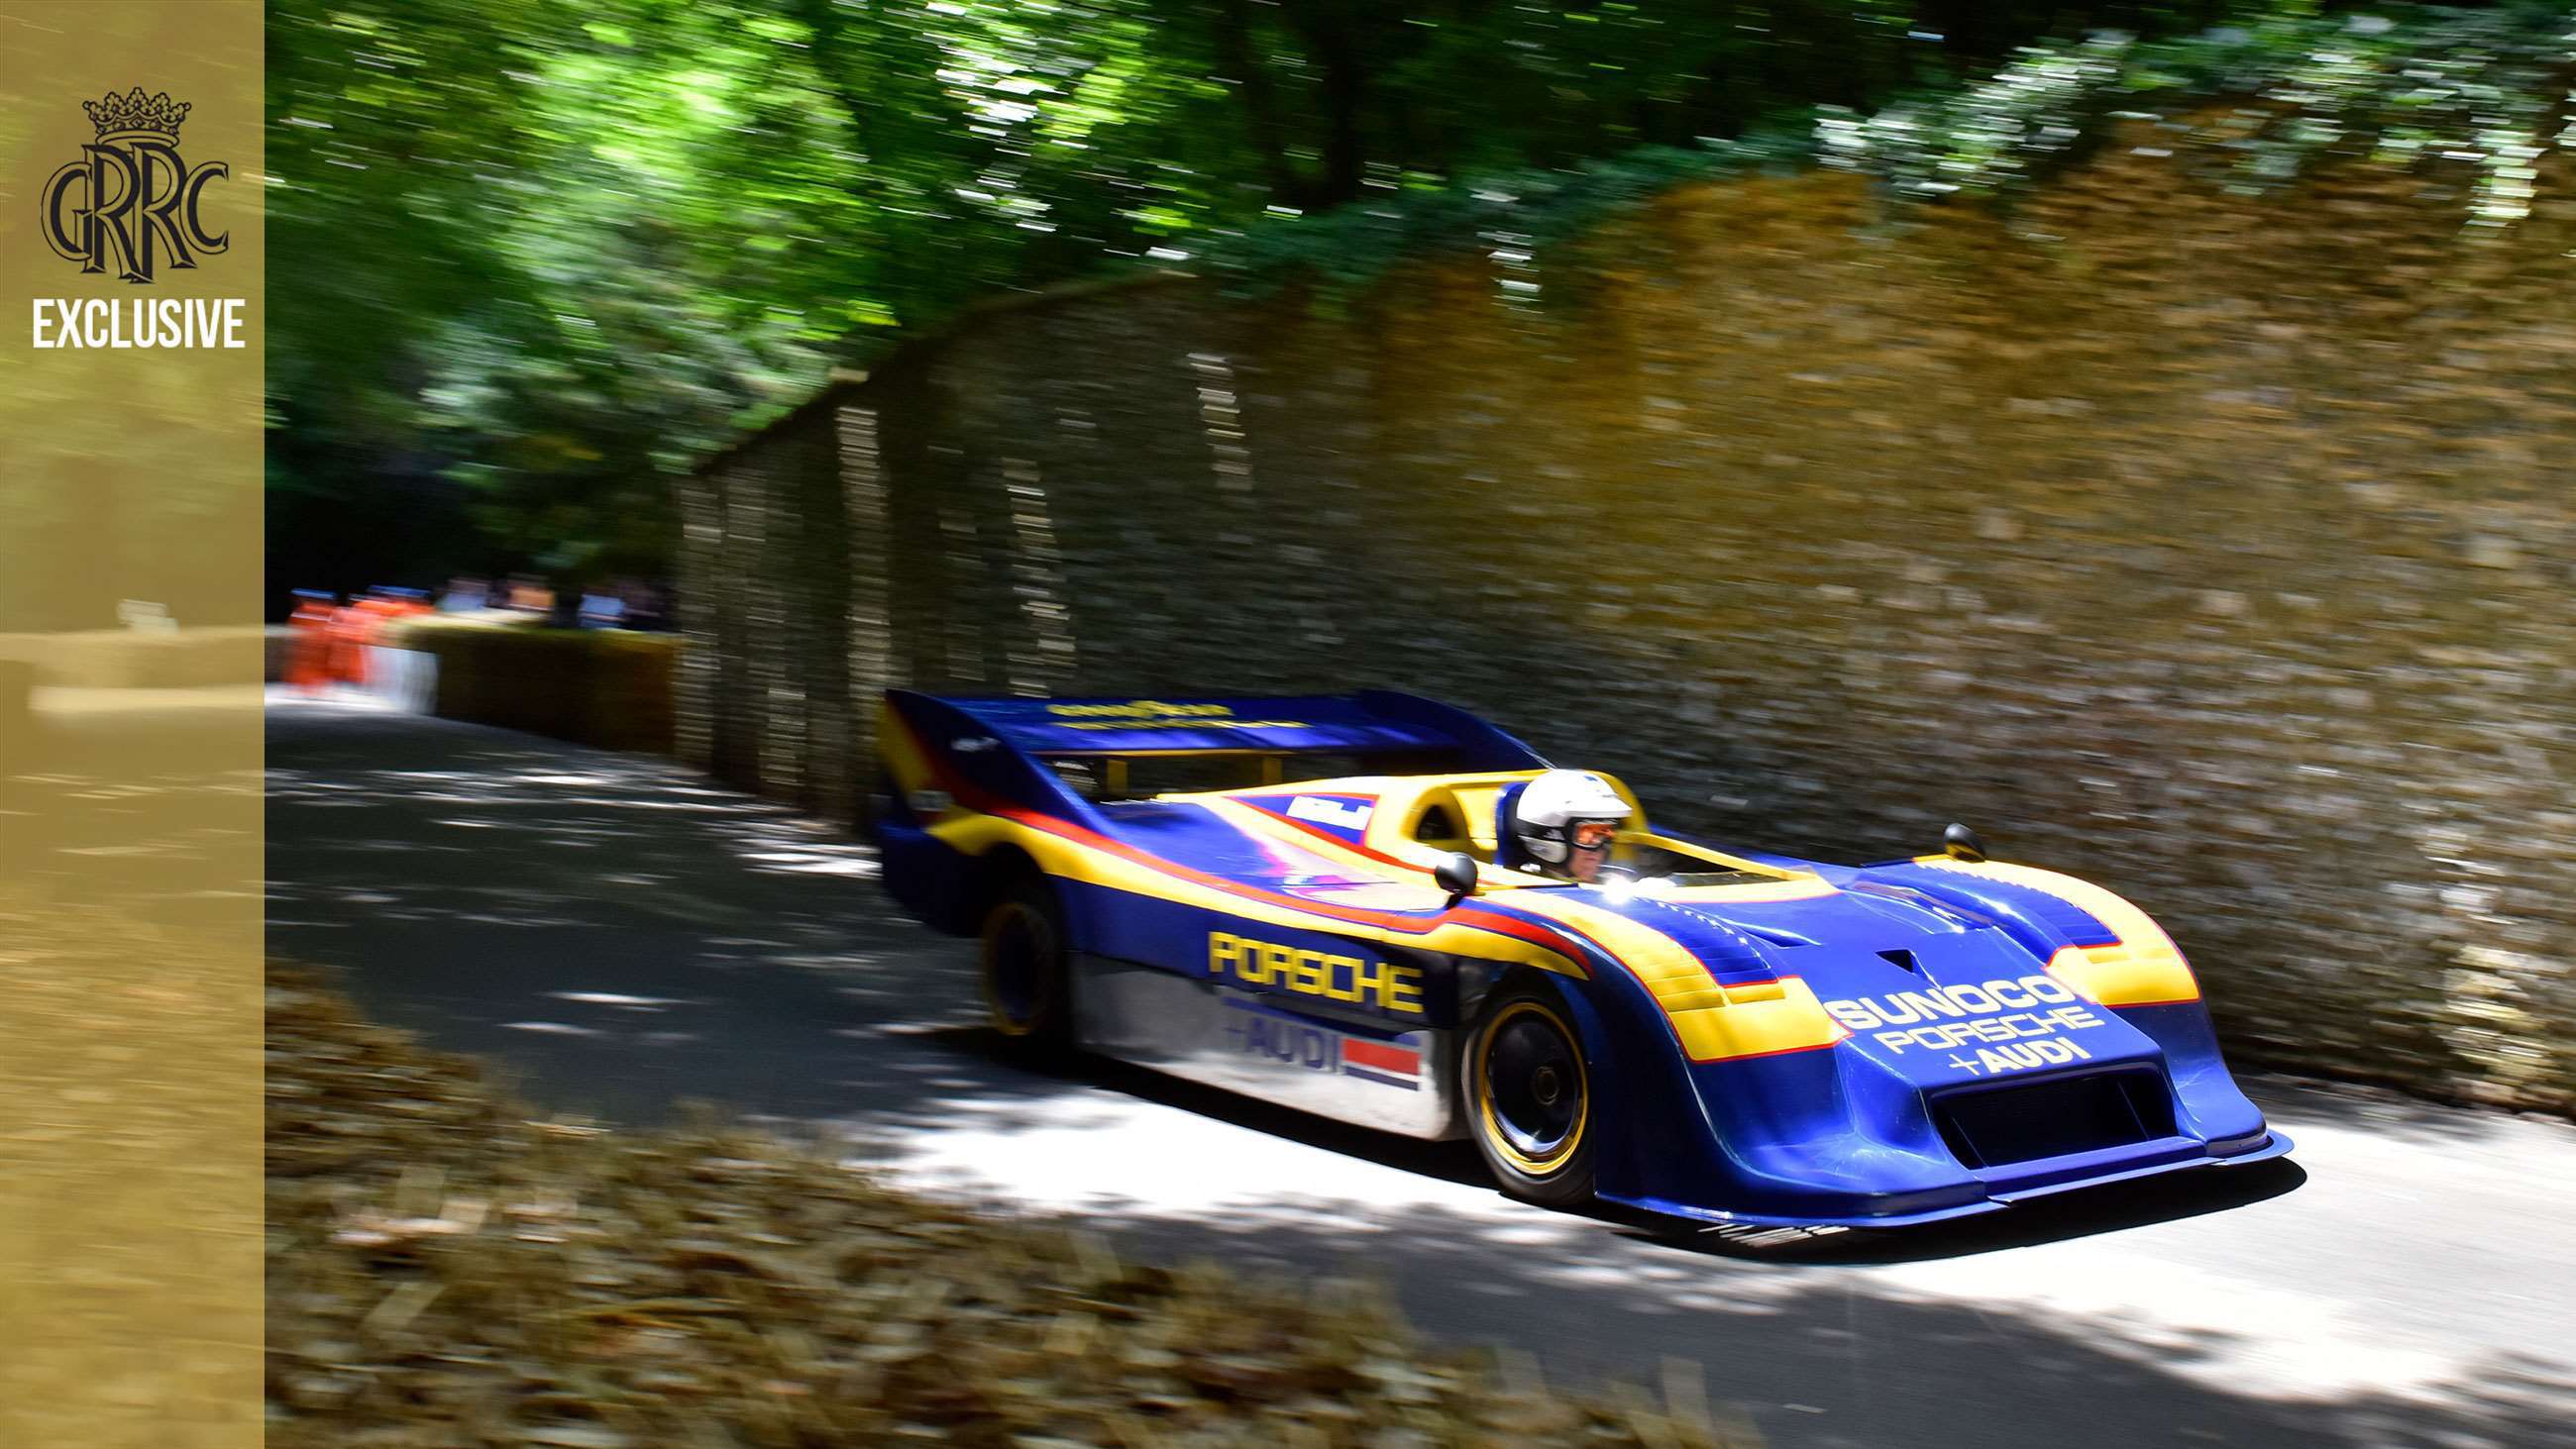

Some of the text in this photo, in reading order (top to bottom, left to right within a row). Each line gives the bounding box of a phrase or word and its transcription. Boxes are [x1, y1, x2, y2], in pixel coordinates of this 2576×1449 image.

[1208, 931, 1425, 1013] PORSCHE
[1823, 975, 2077, 1030] SUNOCO
[1872, 1005, 2105, 1055] PORSCHE
